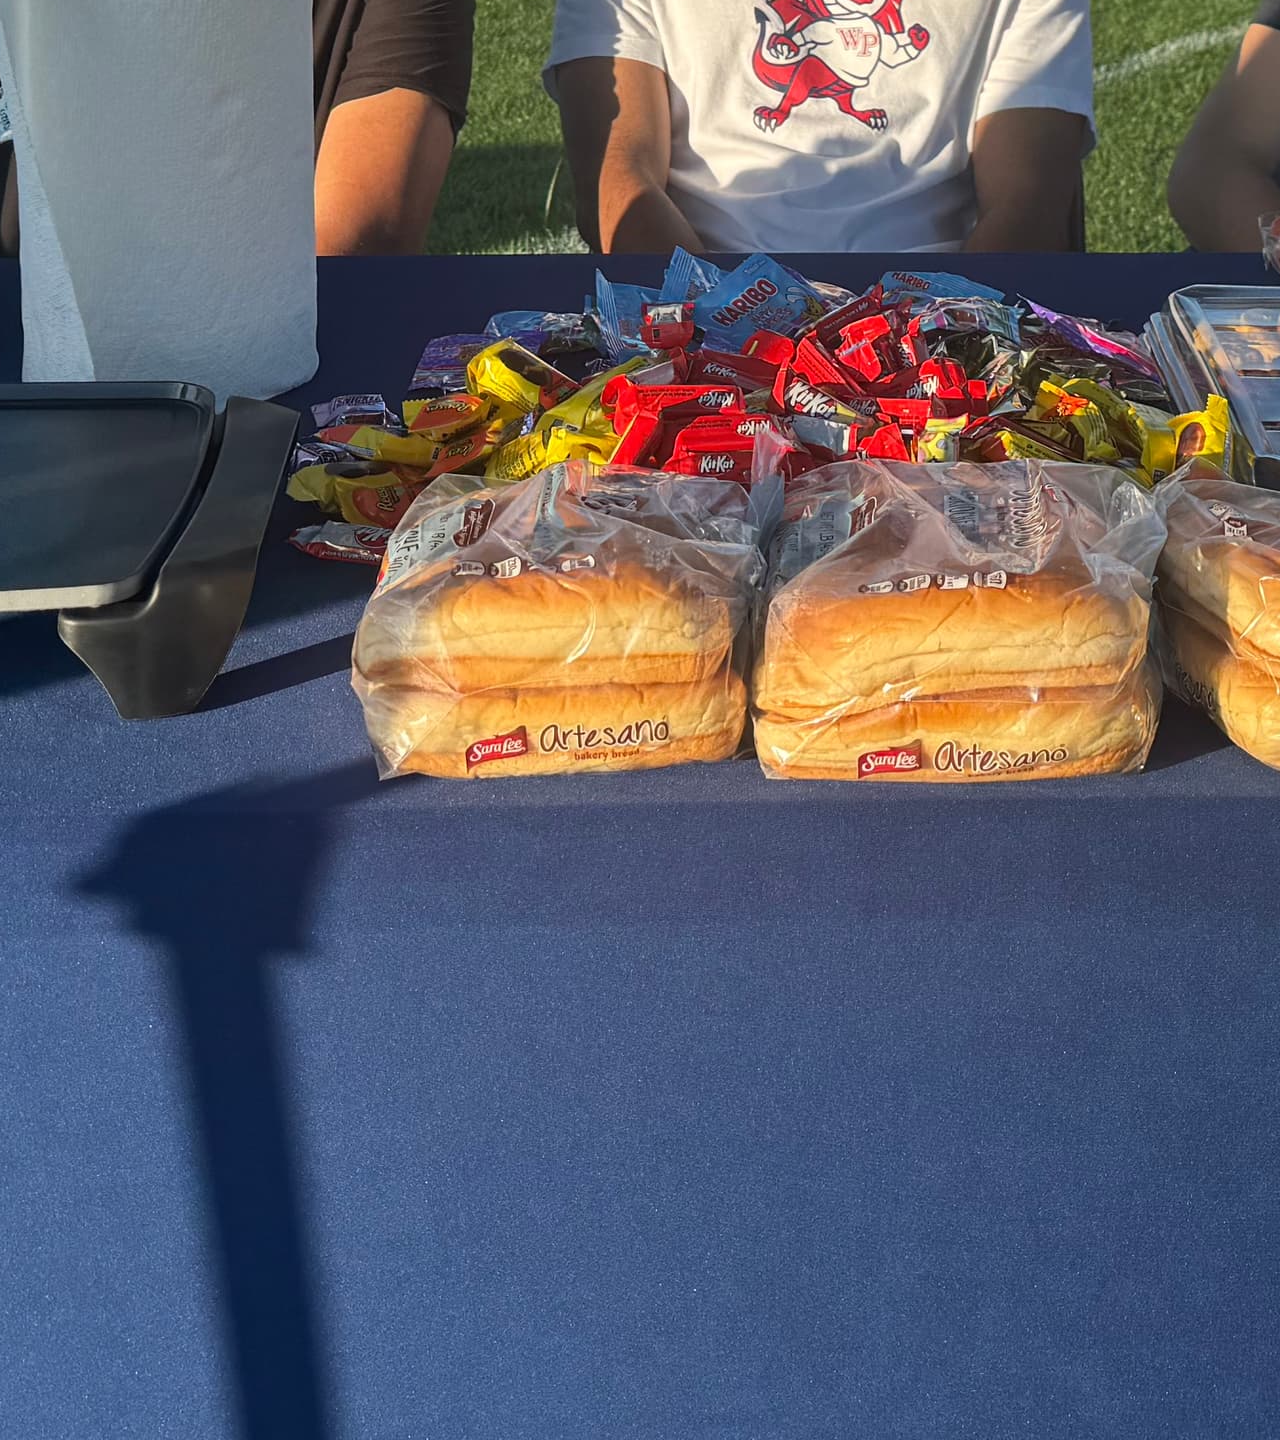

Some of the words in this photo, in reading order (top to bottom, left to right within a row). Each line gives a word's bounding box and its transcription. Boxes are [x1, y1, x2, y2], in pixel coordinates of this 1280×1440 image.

[891, 271, 932, 290] HARIBO
[710, 276, 780, 328] HARIBO
[702, 361, 738, 380] KitKat
[784, 379, 838, 418] KitKat
[700, 455, 736, 474] KitKat
[470, 741, 502, 761] Sara
[501, 735, 527, 756] Lee
[573, 750, 609, 761] bakery
[611, 748, 641, 759] bread
[861, 753, 896, 772] Sara
[895, 750, 919, 769] Lee
